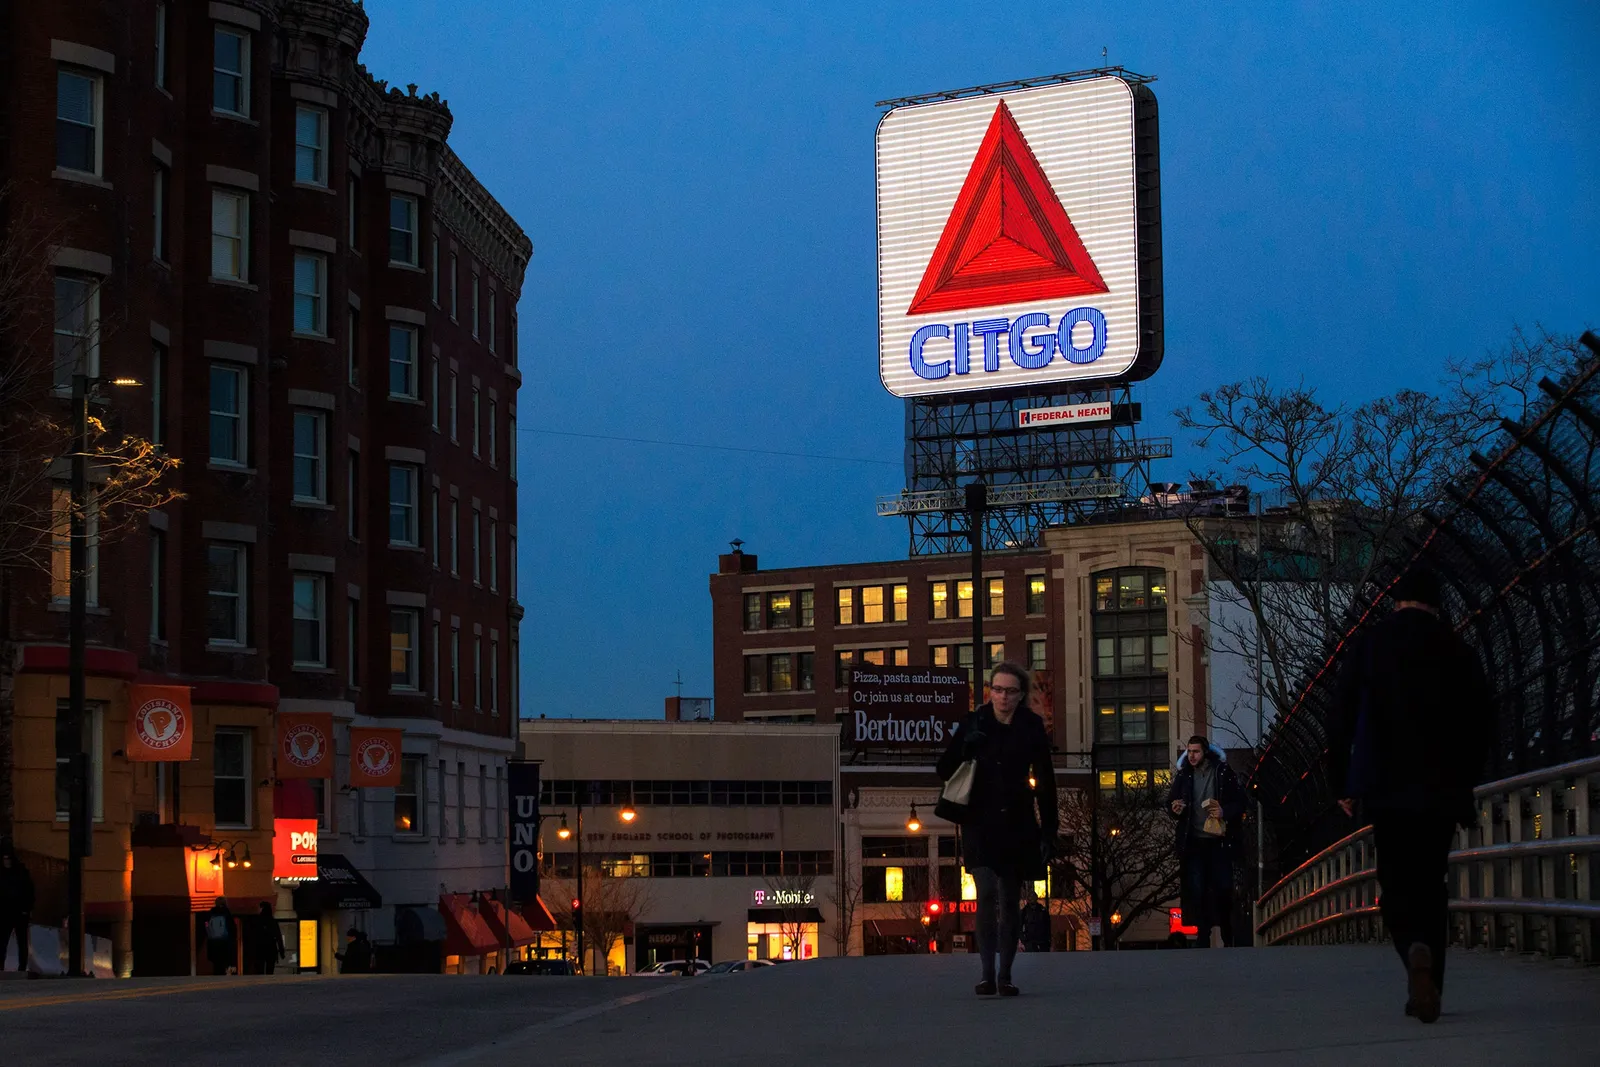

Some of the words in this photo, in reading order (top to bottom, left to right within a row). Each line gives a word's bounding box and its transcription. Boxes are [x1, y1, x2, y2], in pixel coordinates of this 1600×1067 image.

[909, 307, 1107, 379] CITGO
[1031, 410, 1074, 421] FEDERAL
[1078, 407, 1110, 417] HEATH
[854, 671, 881, 684] Pizza,
[884, 672, 910, 685] pasta
[912, 671, 930, 684] and
[932, 676, 965, 684] more...
[854, 690, 867, 702] Or
[869, 691, 888, 705] join
[890, 694, 902, 703] us
[904, 693, 914, 703] at
[915, 694, 933, 703] our
[934, 690, 954, 703] bar!
[137, 700, 182, 720] LOUISIANA
[285, 725, 325, 743] LOUISIANA
[854, 710, 944, 742] Bertucci's
[140, 731, 181, 748] KITCHEN
[513, 795, 536, 873] UNO
[612, 832, 651, 841] ENGLAND
[657, 832, 694, 841] SCHOOL
[700, 832, 712, 841] OF
[717, 832, 775, 841] PHOTOGRAPHY
